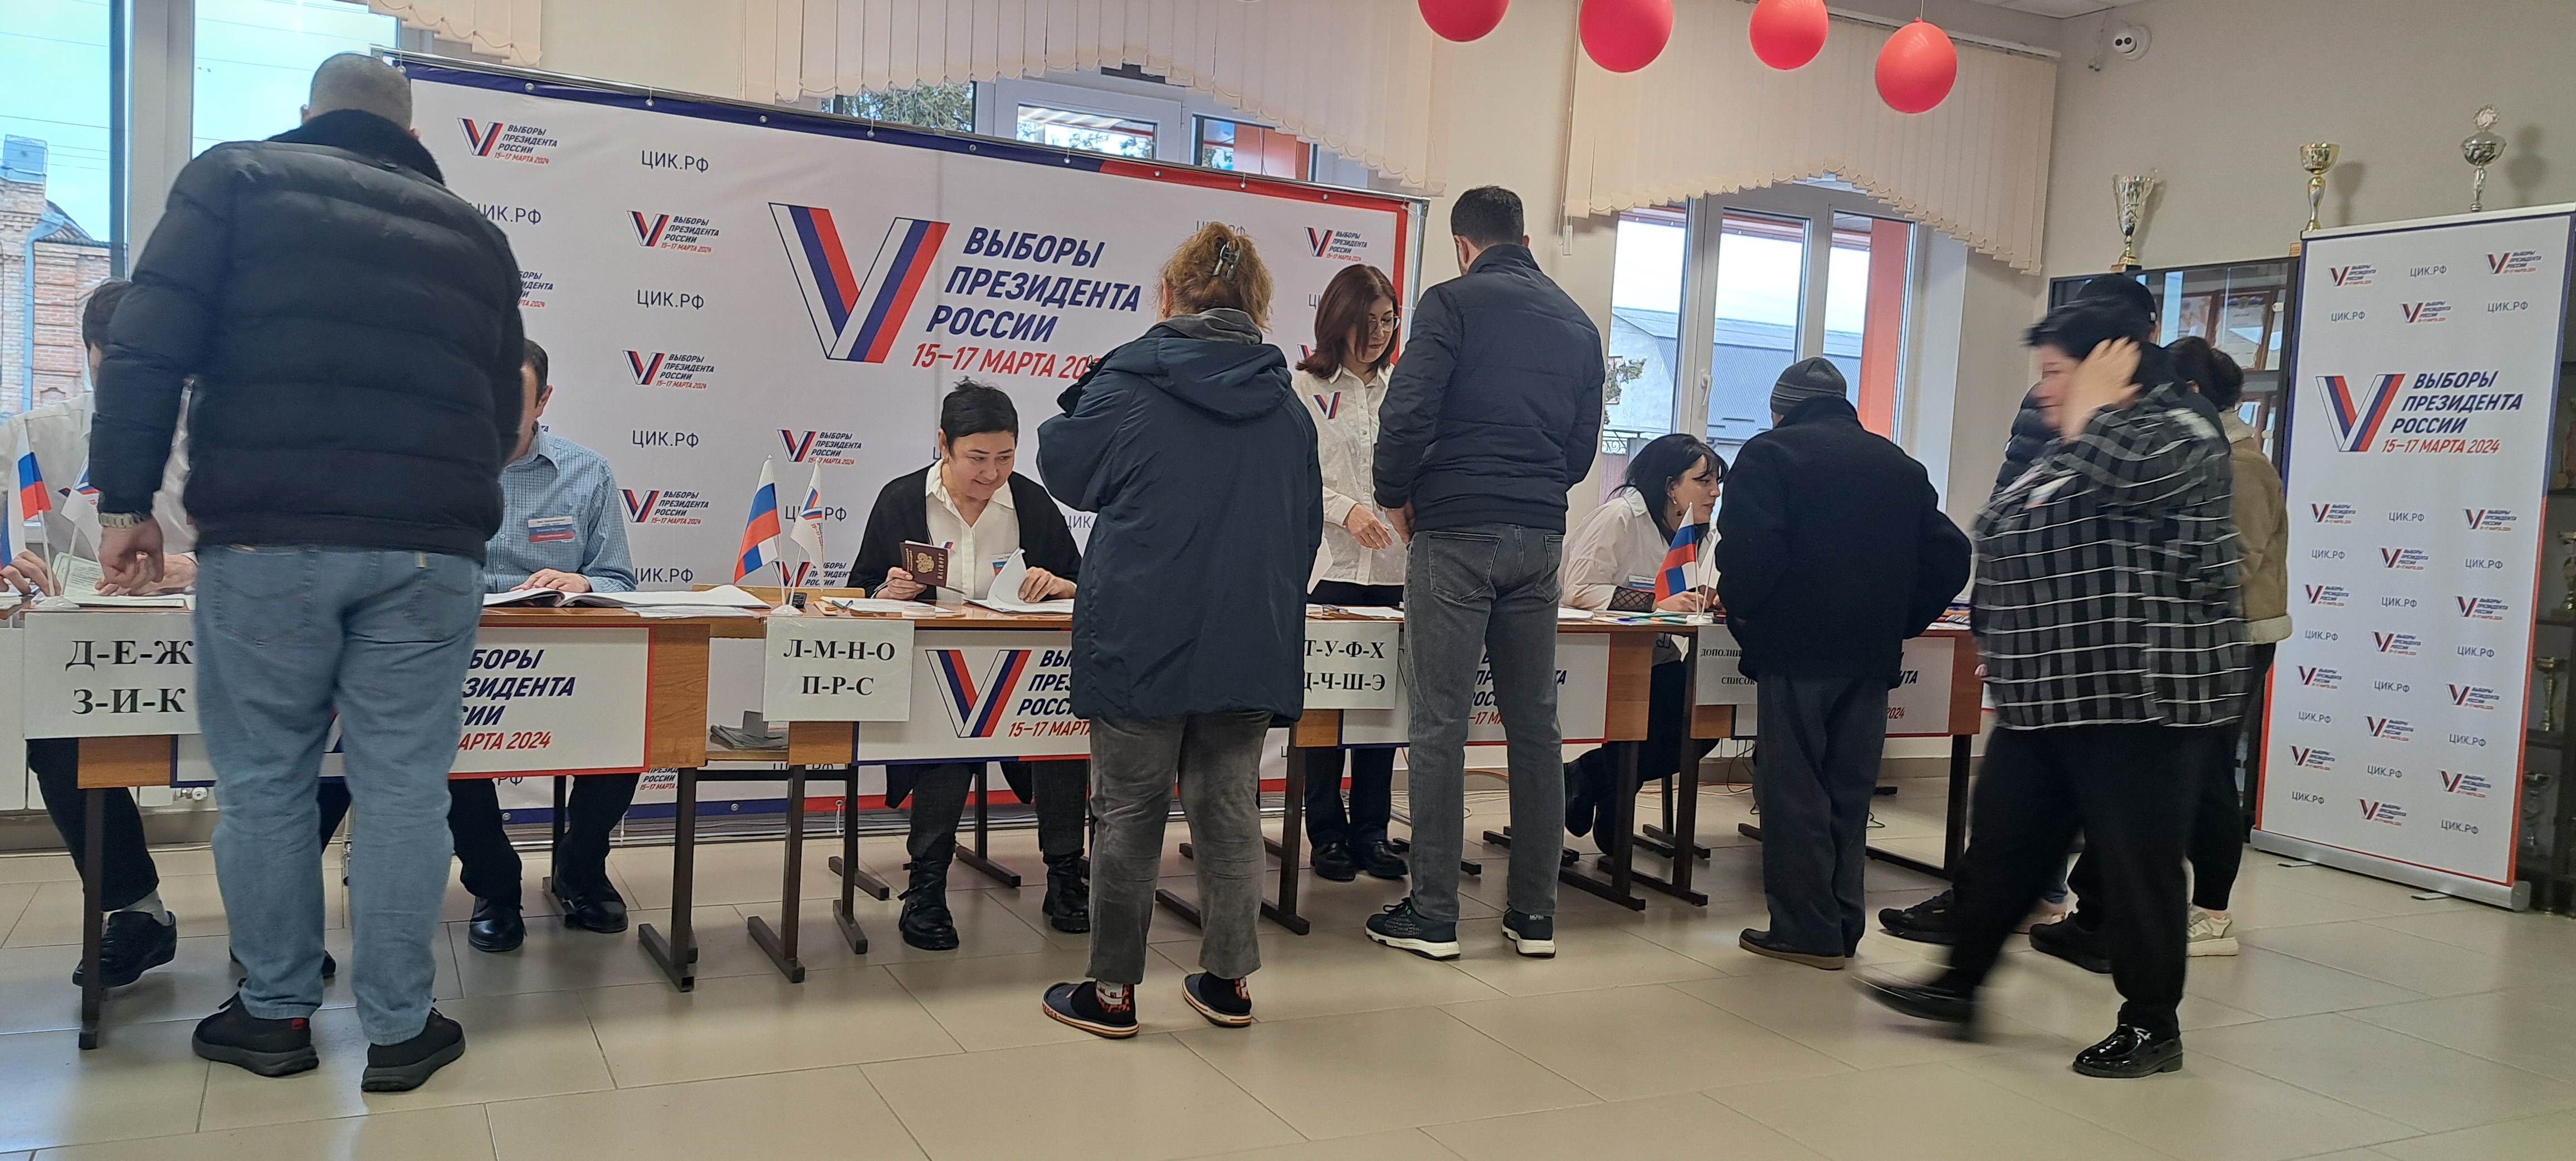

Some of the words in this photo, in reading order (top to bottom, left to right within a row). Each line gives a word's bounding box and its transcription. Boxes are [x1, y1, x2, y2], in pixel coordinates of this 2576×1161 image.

[507, 125, 547, 136] ВЫБОРЫ
[502, 134, 558, 147] ПРЕЗИДЕНТА
[497, 143, 534, 153] РОССИИ
[641, 150, 709, 172] ЦИК.РФ
[477, 203, 541, 225] ИК.РФ
[673, 216, 710, 226] ВЫБОРЫ
[669, 225, 719, 236] ПРЕЗИДЕНТА
[664, 234, 698, 243] РОССИИ
[1332, 238, 1367, 248] ПРЕЗИДЕНТА
[963, 227, 1105, 269] ВЫБОРЫ
[519, 271, 542, 280] БОРЫ
[2410, 265, 2447, 277] ЦИК.РФ
[521, 281, 554, 290] ИДЕНТА
[944, 266, 1141, 312] ПРЕЗИДЕНТА
[637, 290, 704, 310] ЦИК.РФ
[2487, 301, 2528, 313] ЦИК.РФ
[2331, 311, 2365, 322] ЦИК.РФ
[926, 305, 1058, 343] РОССИИ
[669, 354, 705, 363] ВЫБОРЫ
[912, 343, 979, 370] 15–17
[979, 349, 1056, 378] МАРТА
[1057, 355, 1101, 379] 20
[664, 363, 715, 373] ПРЕЗИДЕНТА
[2412, 370, 2499, 390] ВЫБОРЫ
[2401, 393, 2524, 413] ПРЕЗИДЕНТА
[2390, 417, 2468, 433] РОССИИ
[632, 430, 699, 448] ЦИК.РФ
[815, 441, 862, 449] ПРЕЗИДЕНТА
[2382, 440, 2419, 453] 15–17
[2419, 439, 2466, 453] МАРТА
[2466, 438, 2500, 453] 2024
[786, 505, 847, 523] ЦРФ
[2389, 512, 2424, 522] ЦИК.РФ
[1063, 515, 1091, 531] ЦИК
[2311, 549, 2345, 559] ЦИК.РФ
[2465, 559, 2503, 570] ЦИК.РФ
[2382, 597, 2417, 608] ЦИК.РФ
[2305, 631, 2338, 641] ЦИК.РФ
[65, 640, 193, 671] Д-Е-Ж
[783, 639, 895, 661] Л-М-Н-О
[1305, 640, 1385, 658] Т-У-Ф-Х
[1700, 648, 1742, 657] ДОПОЛНИ
[2457, 646, 2494, 658] ЦИК.РФ
[468, 649, 544, 669] БОРЫ
[463, 677, 575, 700] ЗИДЕНТА
[801, 675, 875, 696] П-Р-С
[2374, 680, 2409, 692] ЦИК.РФ
[72, 688, 186, 714] З-И-К
[1017, 698, 1072, 715] РОСС
[1468, 712, 1488, 724] –17
[2298, 711, 2331, 723] ЦИК.РФ
[1008, 721, 1049, 737] 15–17
[458, 733, 504, 750] АРТА
[506, 731, 552, 749] 2024
[2449, 734, 2486, 747] ЦИК.РФ
[2367, 765, 2402, 778] ЦИК.РФ
[2292, 792, 2324, 804] ЦИК.РФ
[2441, 819, 2479, 834] ЦИК.РФ
